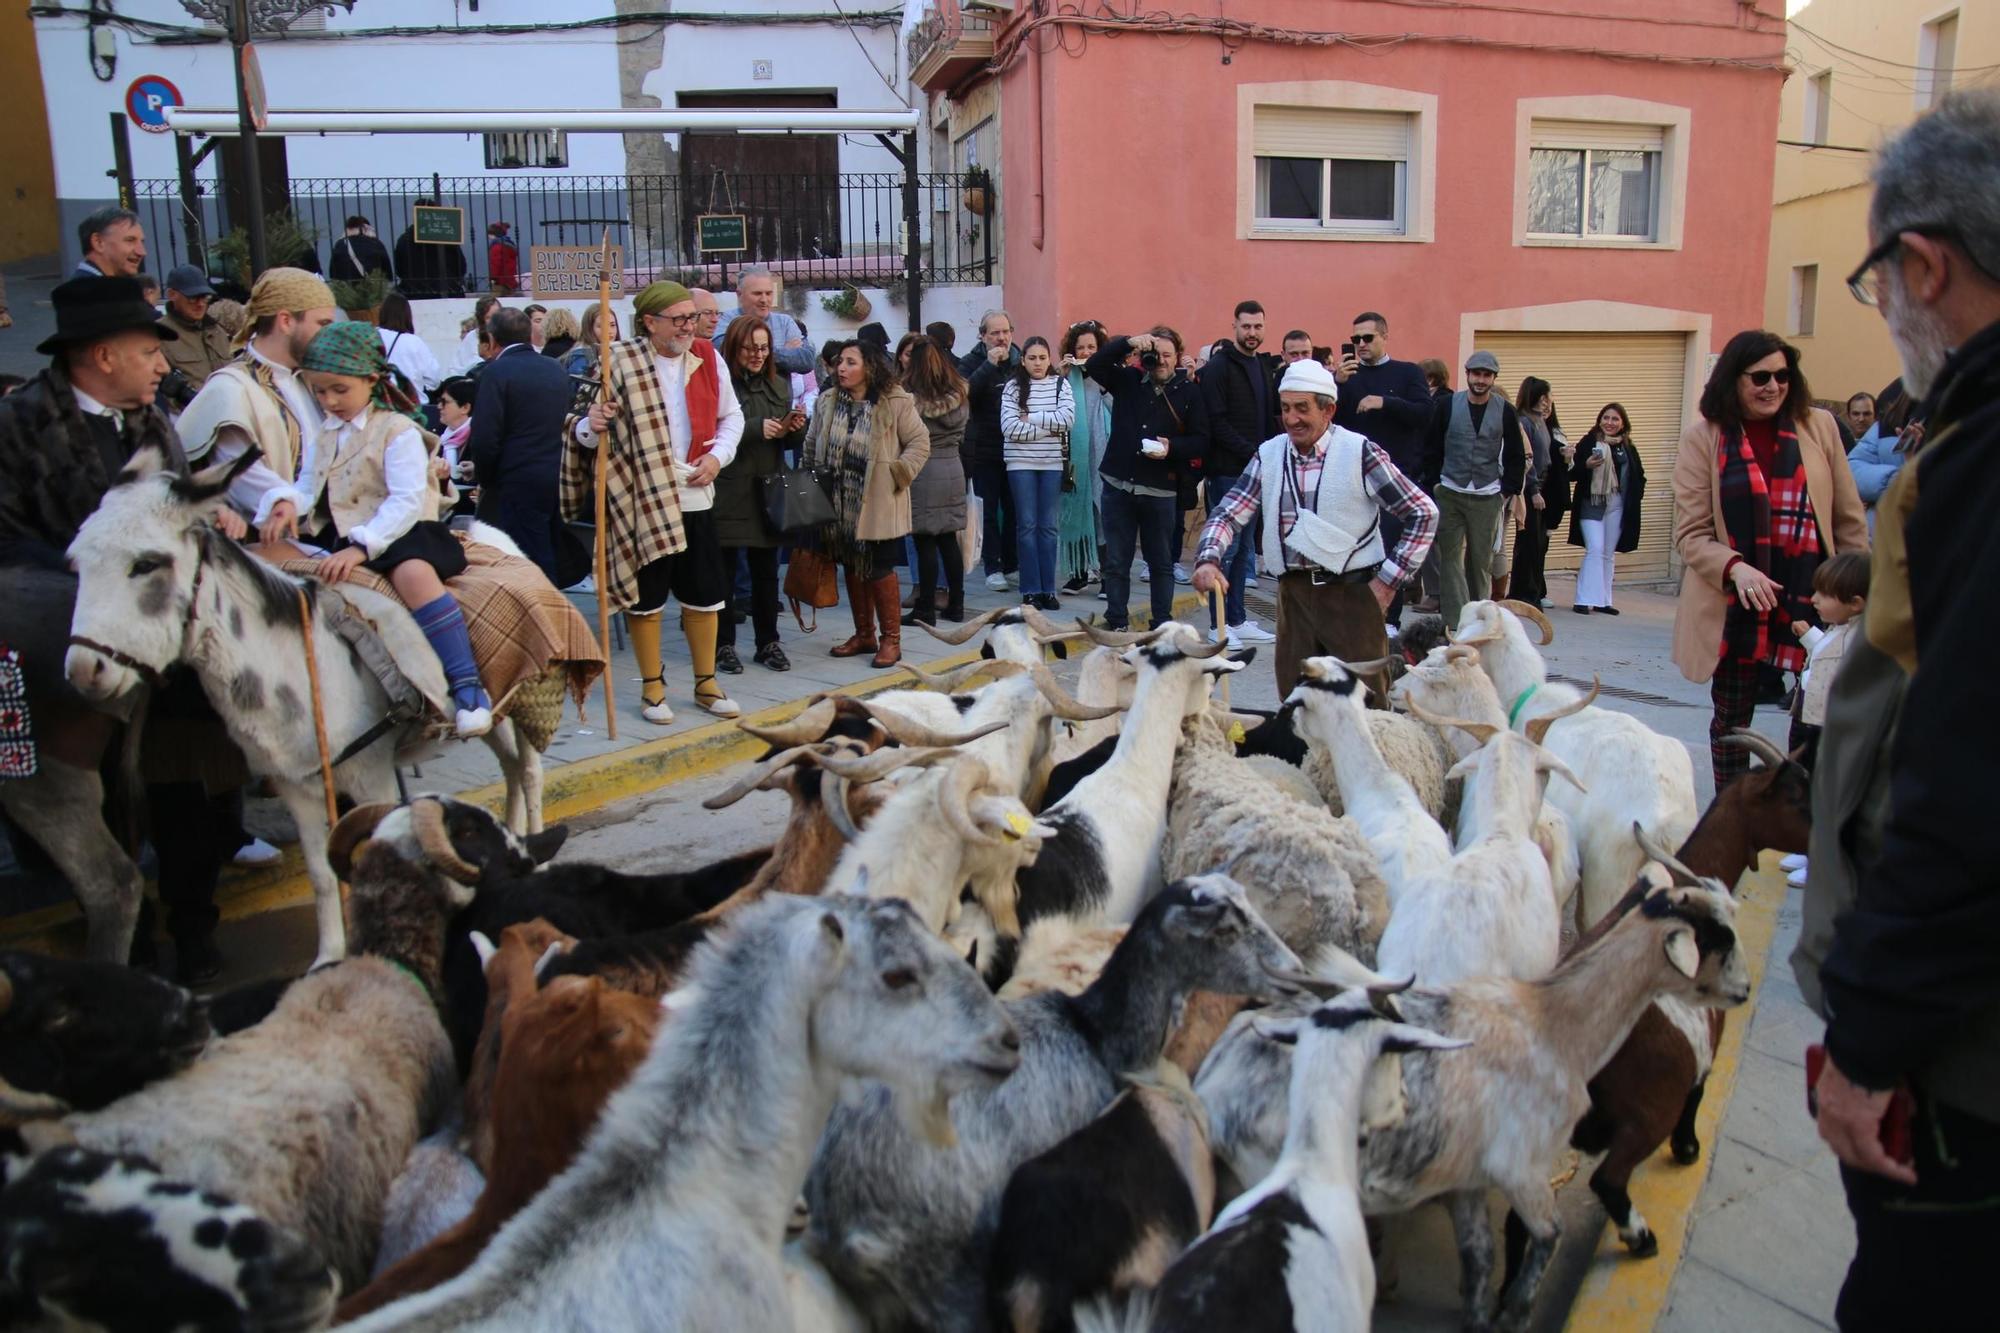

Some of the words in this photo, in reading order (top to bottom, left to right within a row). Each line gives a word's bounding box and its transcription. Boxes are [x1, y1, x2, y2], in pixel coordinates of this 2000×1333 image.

[147, 94, 162, 111] P
[536, 251, 604, 270] BUNYOLS
[612, 251, 617, 269] I
[537, 273, 620, 291] ORELLETS
